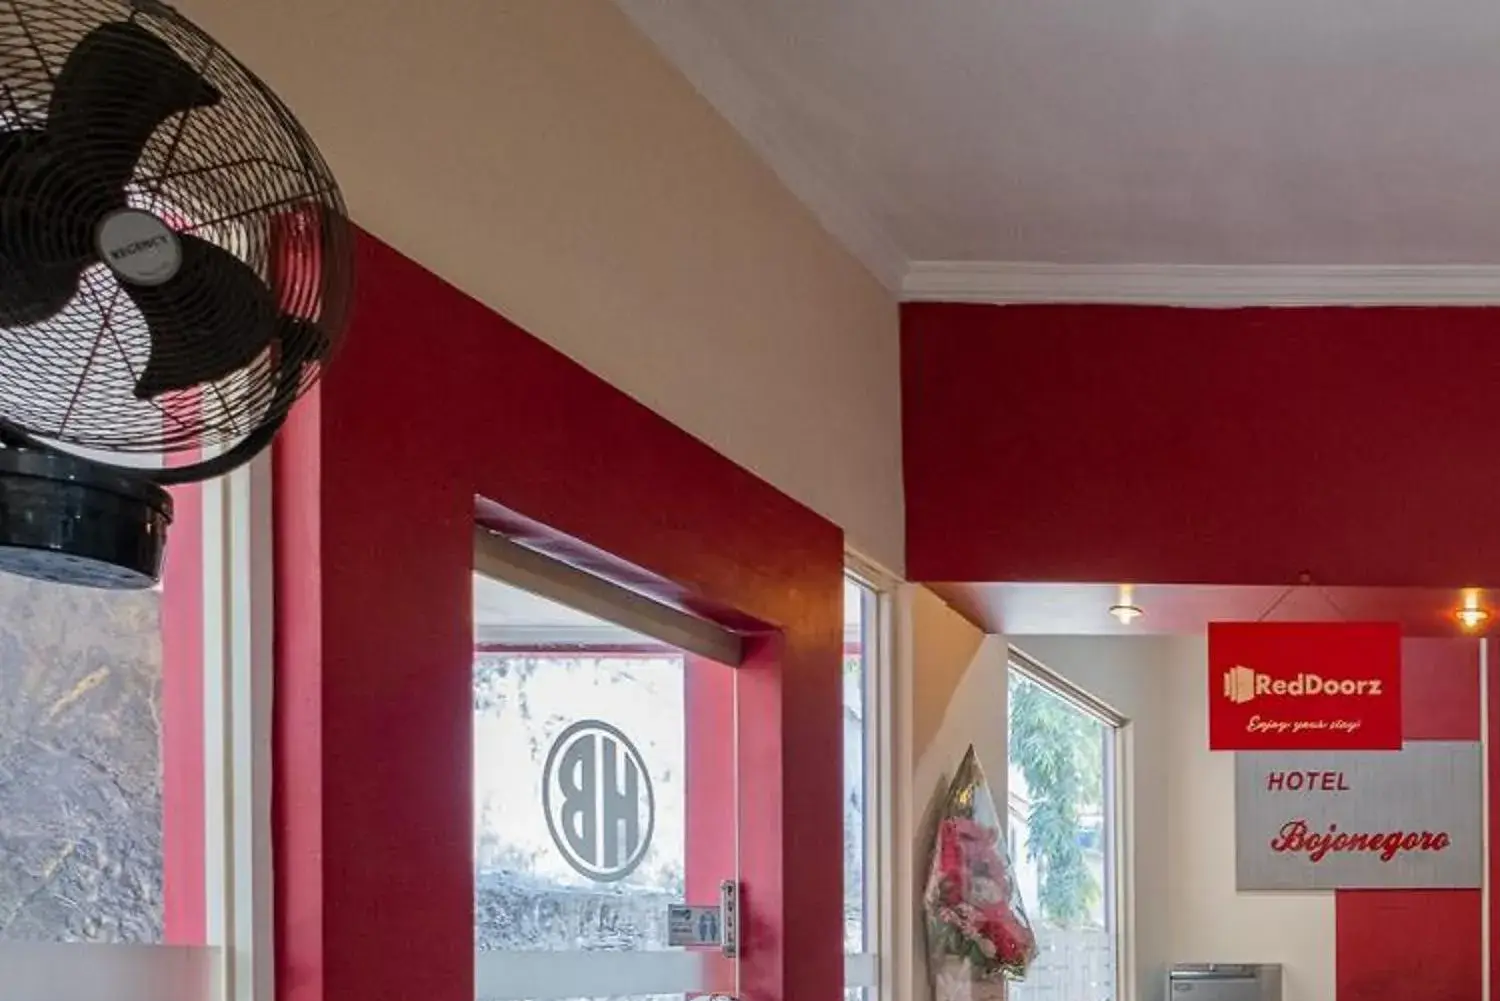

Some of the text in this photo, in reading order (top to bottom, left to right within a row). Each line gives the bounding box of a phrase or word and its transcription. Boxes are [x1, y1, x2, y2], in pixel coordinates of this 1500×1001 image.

[1255, 674, 1382, 695] RedDoorz
[1246, 715, 1290, 733] Enjoy
[1267, 772, 1350, 791] HOTEL
[1271, 820, 1451, 862] Bojonegoro
